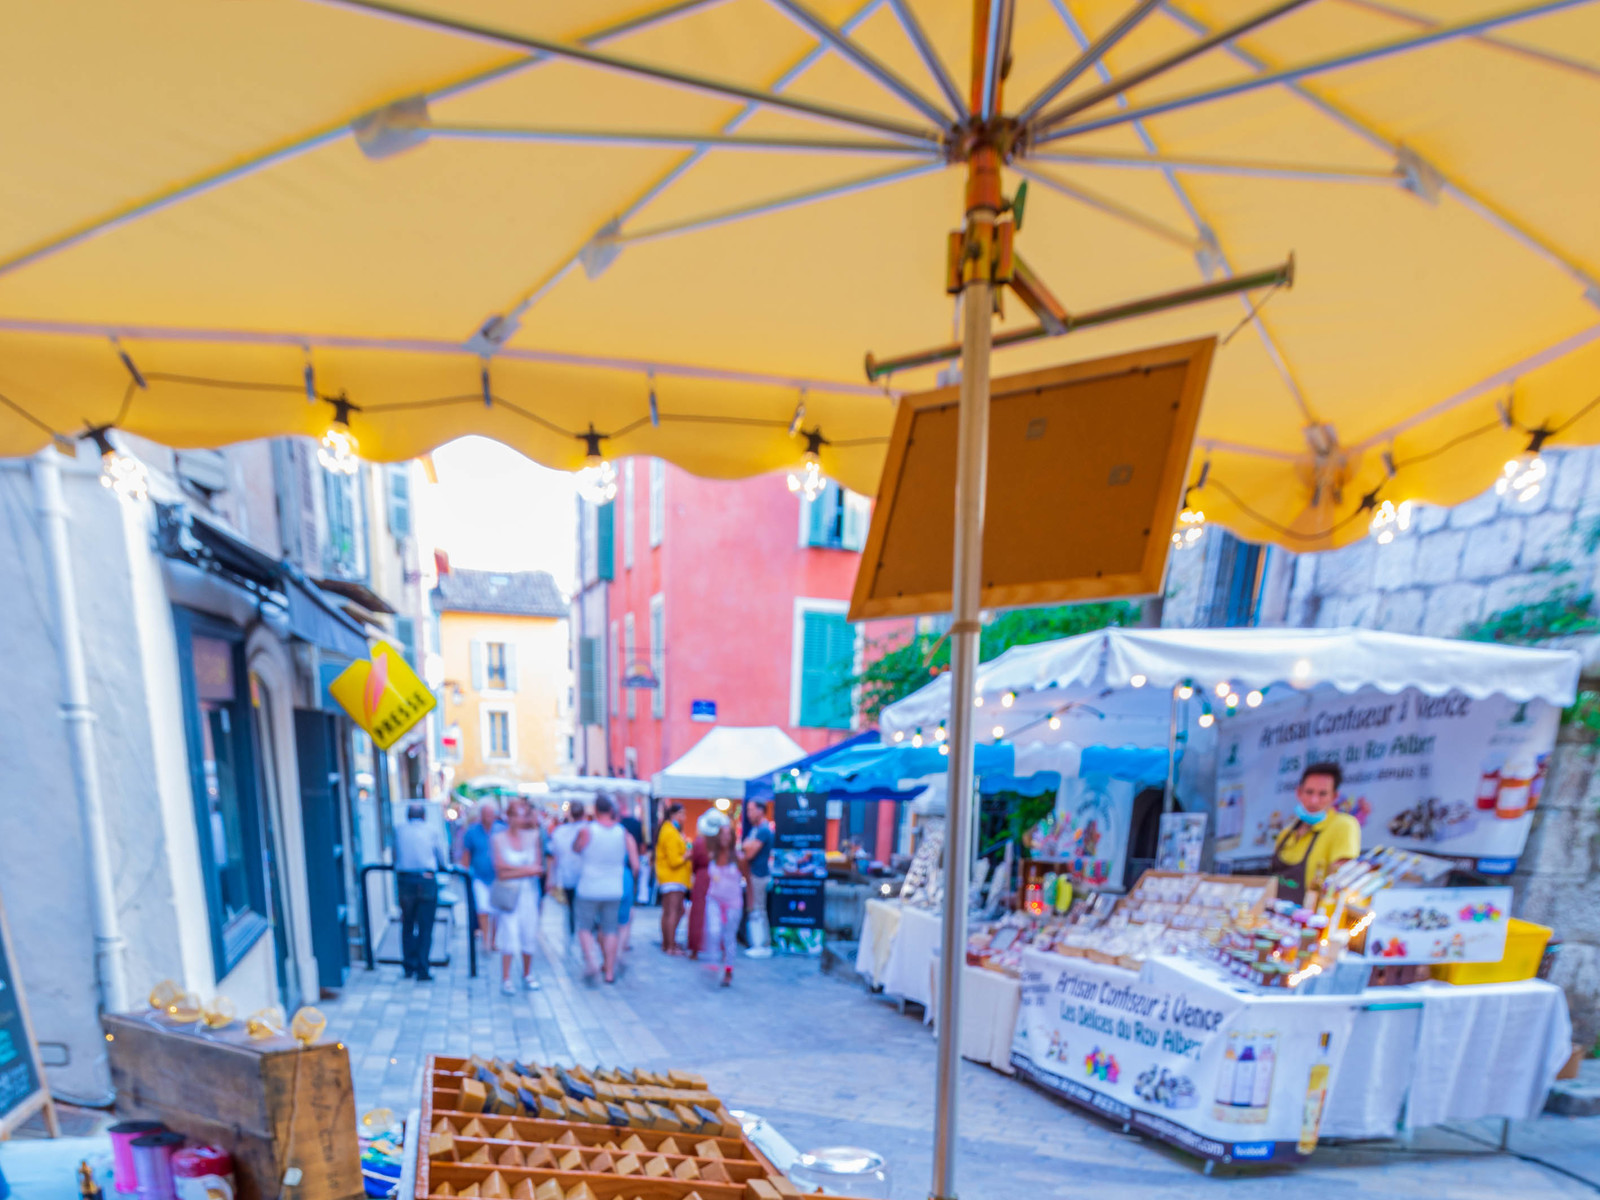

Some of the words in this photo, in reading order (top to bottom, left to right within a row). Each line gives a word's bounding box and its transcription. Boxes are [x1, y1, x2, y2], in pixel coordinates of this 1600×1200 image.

[373, 691, 427, 741] PRESSE
[1055, 970, 1098, 1000] Artisan
[1098, 980, 1159, 1017] Confiseur
[1172, 993, 1223, 1032] Vence
[1060, 1000, 1076, 1023] Les
[1078, 1004, 1114, 1035] Délices
[1116, 1016, 1132, 1040] du
[1134, 1021, 1160, 1047] Roy
